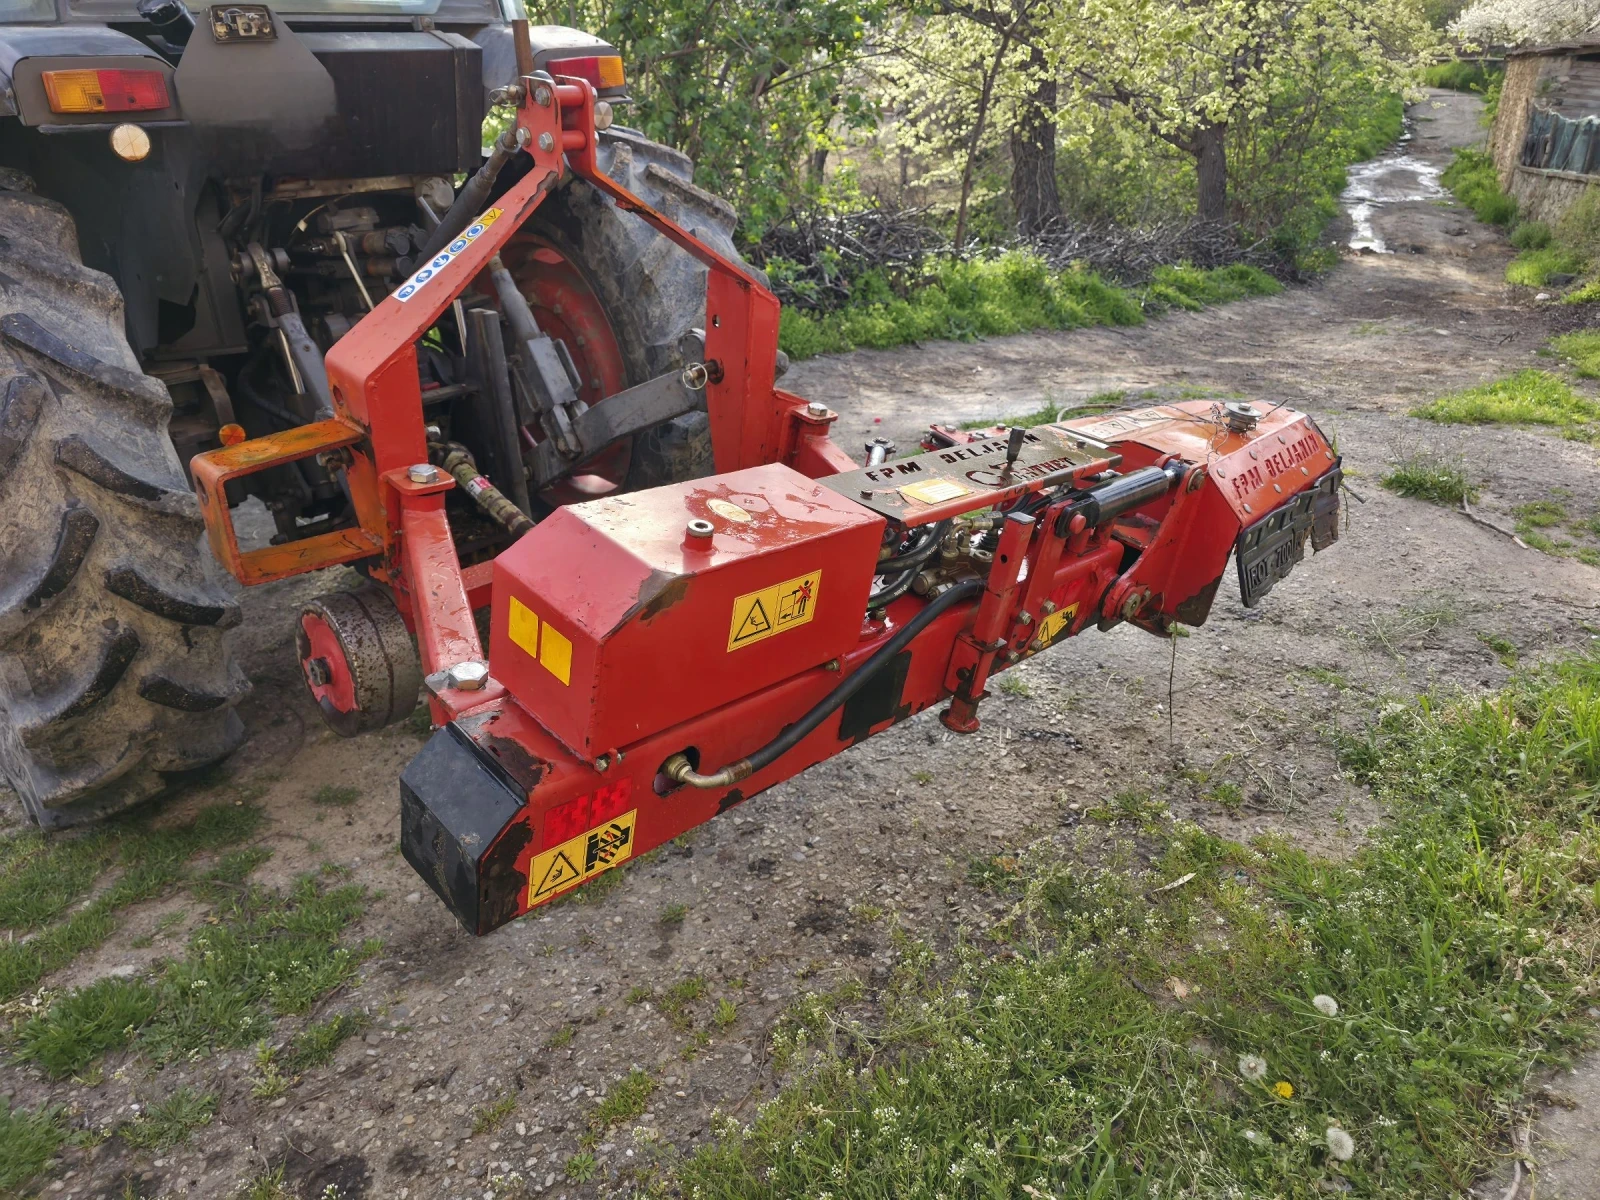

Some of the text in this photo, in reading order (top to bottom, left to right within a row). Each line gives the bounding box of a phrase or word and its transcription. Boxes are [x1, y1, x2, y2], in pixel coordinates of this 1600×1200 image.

[865, 433, 1041, 482] FPM DELJAN
[1231, 433, 1319, 499] FPM DELJANIN
